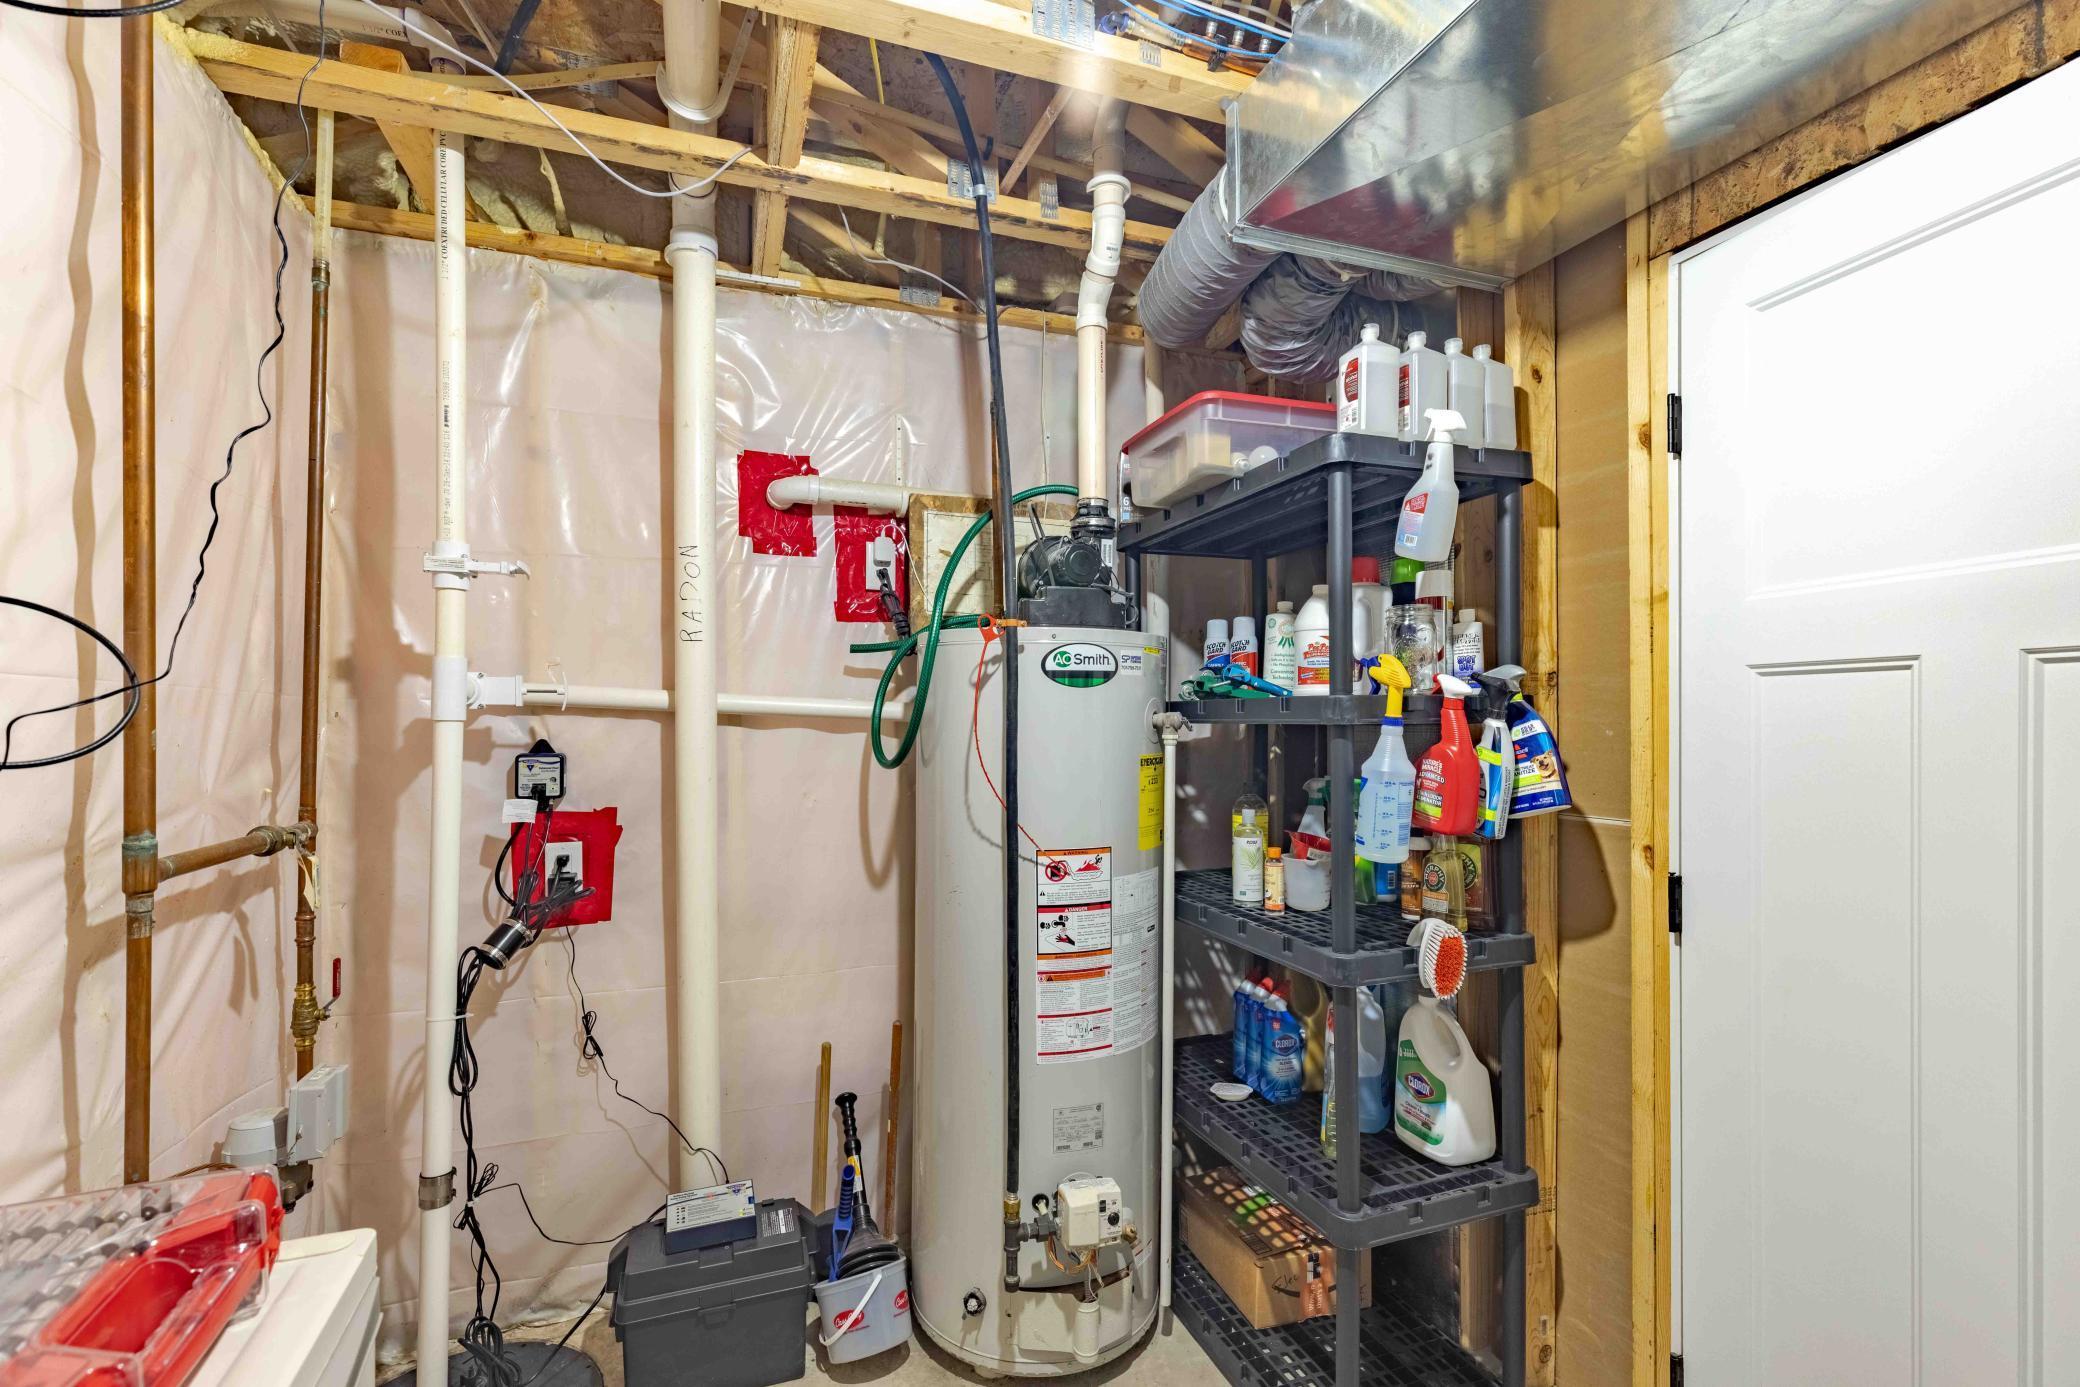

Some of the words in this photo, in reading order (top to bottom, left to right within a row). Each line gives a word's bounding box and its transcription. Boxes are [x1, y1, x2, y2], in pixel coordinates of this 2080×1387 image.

[440, 169, 448, 208] CELLULAR
[440, 209, 448, 259] COEXTRUDED
[678, 545, 703, 642] RADON
[1074, 653, 1110, 665] Smith
